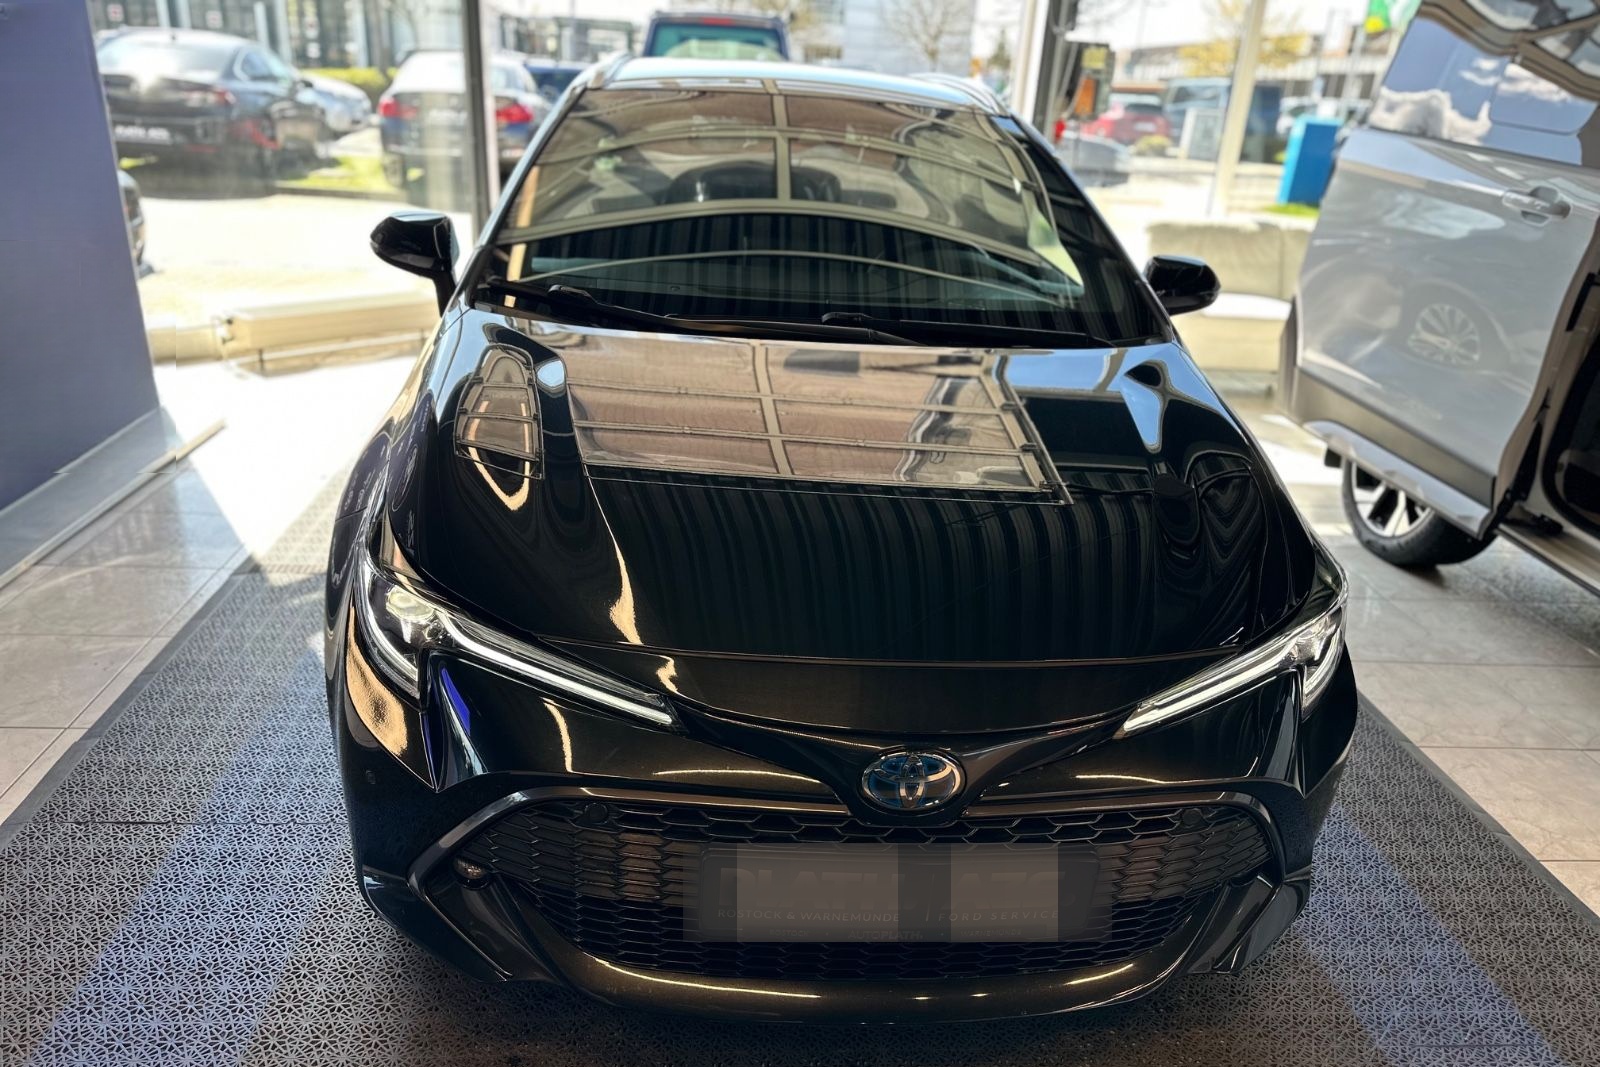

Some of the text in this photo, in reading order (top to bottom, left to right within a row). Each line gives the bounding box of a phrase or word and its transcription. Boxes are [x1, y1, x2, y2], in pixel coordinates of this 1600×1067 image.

[718, 909, 1059, 922] ROSTOCK & WARNEMÜNDE FORD SERVICE
